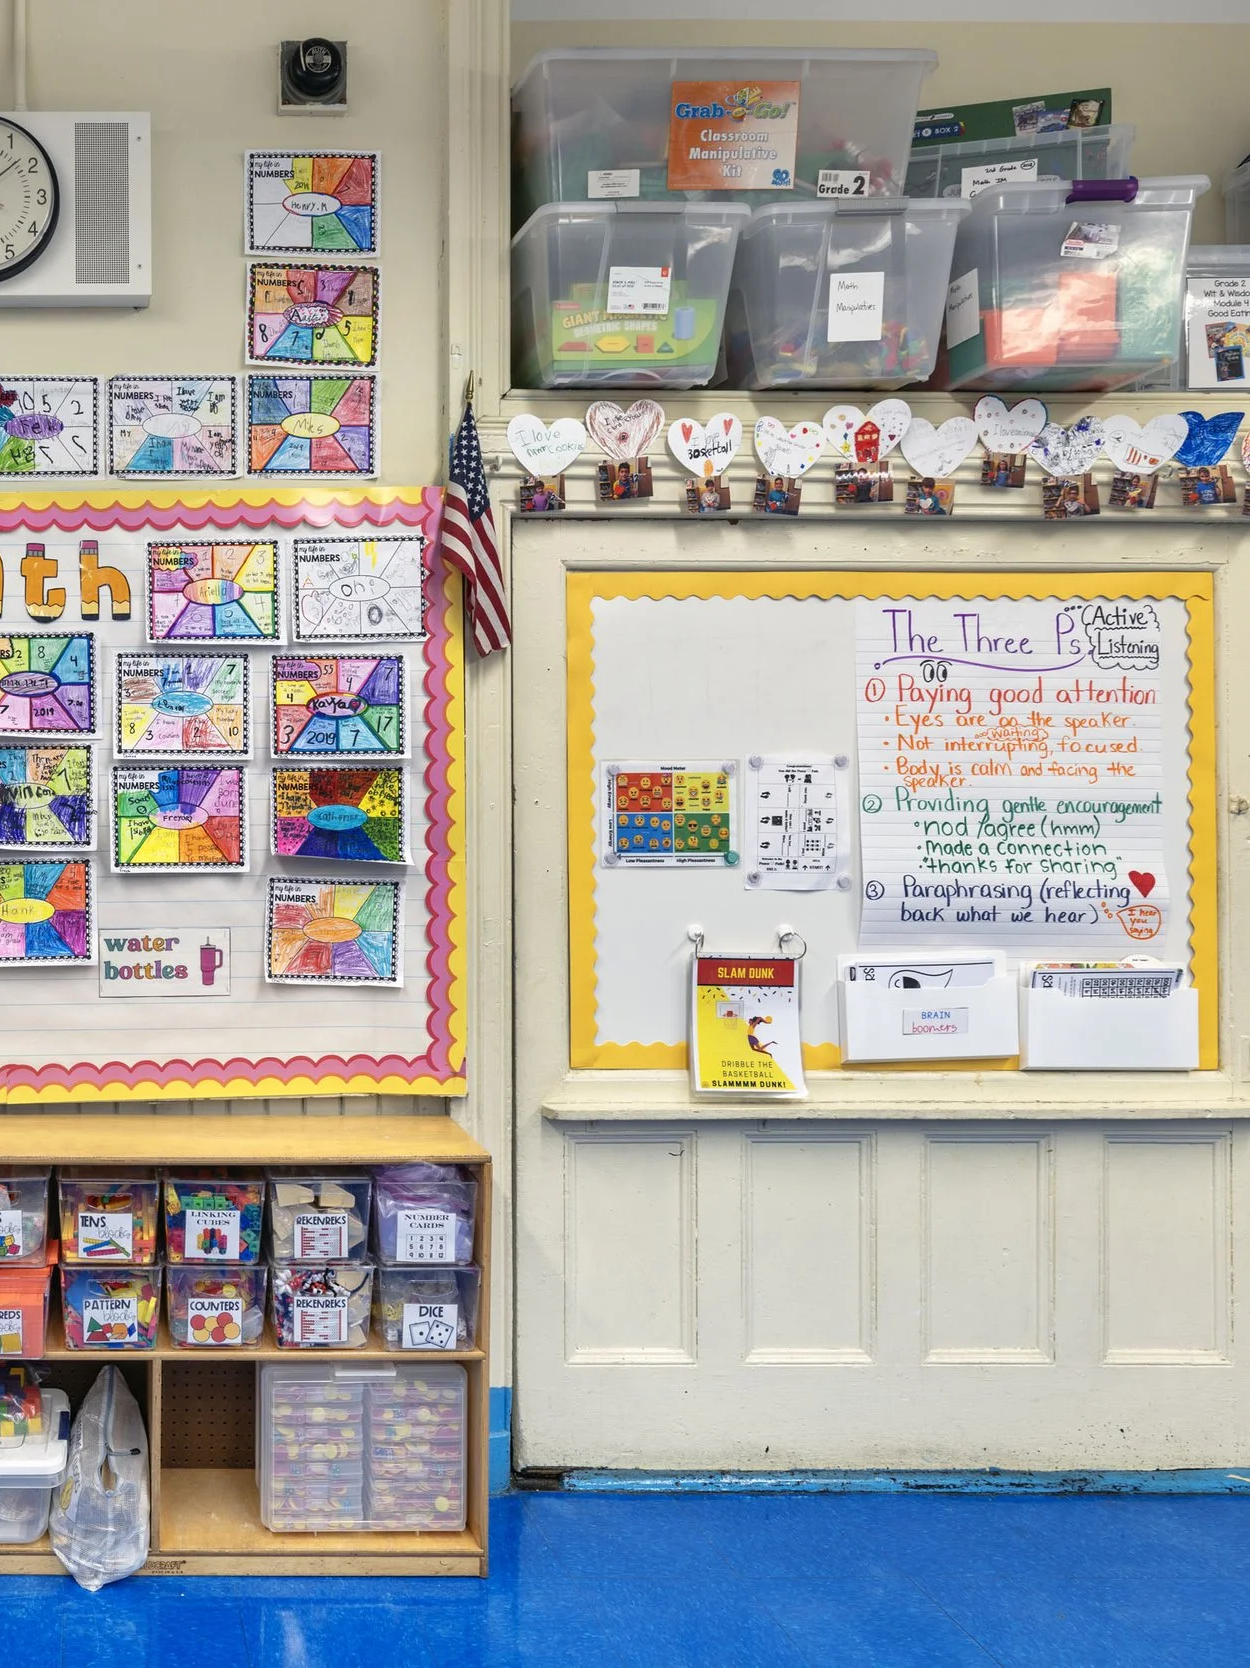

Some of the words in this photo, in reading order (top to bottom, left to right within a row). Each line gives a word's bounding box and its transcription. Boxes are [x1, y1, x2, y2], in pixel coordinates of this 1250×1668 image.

[700, 129, 769, 143] Classroom
[689, 148, 777, 162] Manipulative
[254, 170, 294, 178] NUMBERS
[722, 164, 742, 177] Kit
[818, 183, 849, 195] Grade
[852, 176, 865, 195] 2
[28, 221, 38, 234] 4
[257, 279, 296, 287] NUMBERS
[1214, 280, 1240, 288] Grade
[1241, 280, 1247, 288] 2
[1243, 299, 1249, 307] 4
[563, 310, 602, 329] GIANT
[574, 322, 621, 338] GEOMETRIC
[623, 320, 657, 333] SHAPES
[114, 391, 154, 400] NUMBERS
[153, 557, 194, 566] NUMBERS
[299, 554, 340, 562] NUMBERS
[1092, 605, 1148, 628] Active
[883, 609, 944, 653] The
[954, 613, 1033, 655] Three
[1057, 612, 1081, 656] Ps
[1098, 633, 1159, 657] Listening
[898, 674, 972, 715] Paying
[989, 676, 1043, 715] good
[1056, 676, 1156, 705] attention
[895, 704, 944, 732] Eyes
[956, 713, 986, 728] are
[1028, 711, 1055, 728] the
[307, 731, 335, 744] 2019
[992, 727, 1040, 743] waiting
[897, 735, 934, 751] Not
[896, 755, 940, 782] Body
[949, 763, 962, 776] is
[971, 762, 1011, 776] calm
[1020, 762, 1043, 776] and
[1048, 762, 1098, 785] facing
[1107, 761, 1137, 776] the
[119, 782, 160, 790] NUMBERS
[895, 785, 990, 825] Providing
[1002, 796, 1048, 823] gentle
[1056, 792, 1163, 824] encouragement
[926, 841, 973, 856] made
[979, 844, 990, 856] a
[903, 874, 1033, 909] Paraphrasing
[275, 894, 316, 903] NUMBERS
[901, 905, 945, 924] back
[956, 907, 1002, 923] what
[1011, 910, 1034, 923] we
[104, 935, 180, 952] water
[104, 960, 189, 980] bottles
[717, 967, 746, 979] SLAM
[749, 967, 775, 979] DUNK
[921, 1011, 950, 1019] BRAIN
[911, 1022, 958, 1034] boomers
[721, 1060, 755, 1068] DRIBBLE
[723, 1070, 774, 1078] BASKETBALL
[191, 1210, 236, 1218] LINKING
[296, 1215, 346, 1226] REKENREKS
[404, 1214, 449, 1222] NUMBER
[80, 1215, 106, 1228] TENS
[98, 1227, 131, 1239] blocks
[84, 1299, 131, 1310] PATTERN
[190, 1301, 240, 1312] COUNTERS
[296, 1299, 346, 1309] REKENREKS
[103, 1310, 136, 1322] blocks
[419, 1305, 444, 1318] DICE
